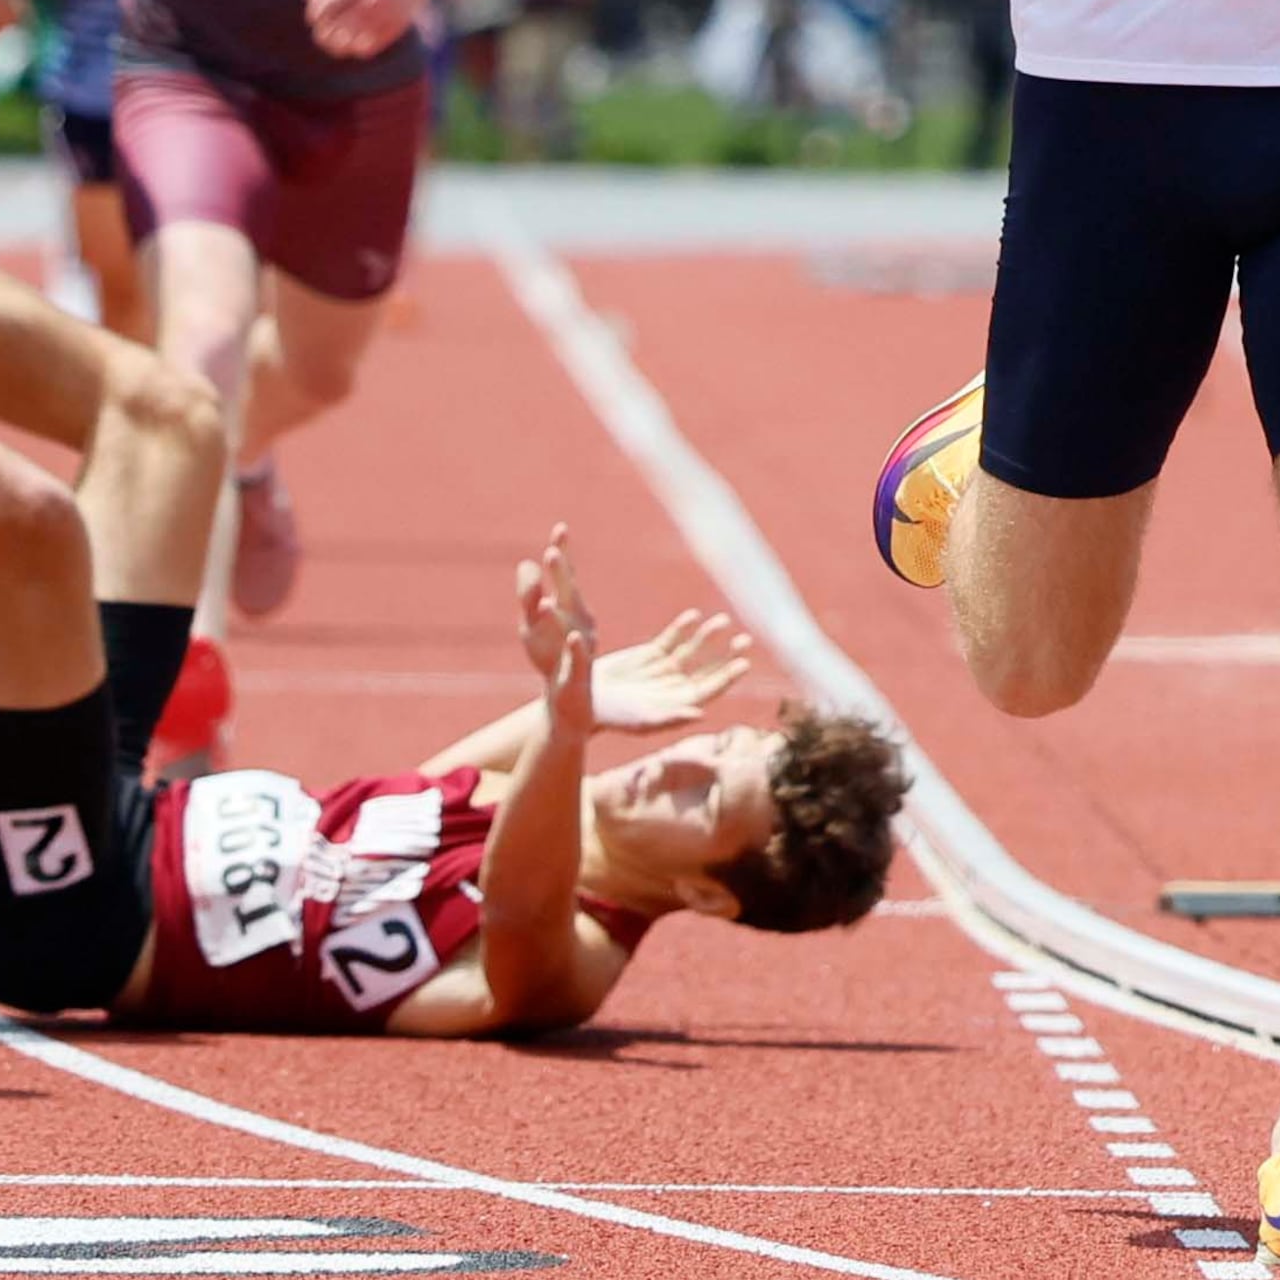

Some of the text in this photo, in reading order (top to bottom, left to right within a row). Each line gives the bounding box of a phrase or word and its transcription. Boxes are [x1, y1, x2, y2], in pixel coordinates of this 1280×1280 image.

[10, 815, 77, 882] 2
[218, 792, 282, 936] 5681
[329, 919, 419, 995] 2
